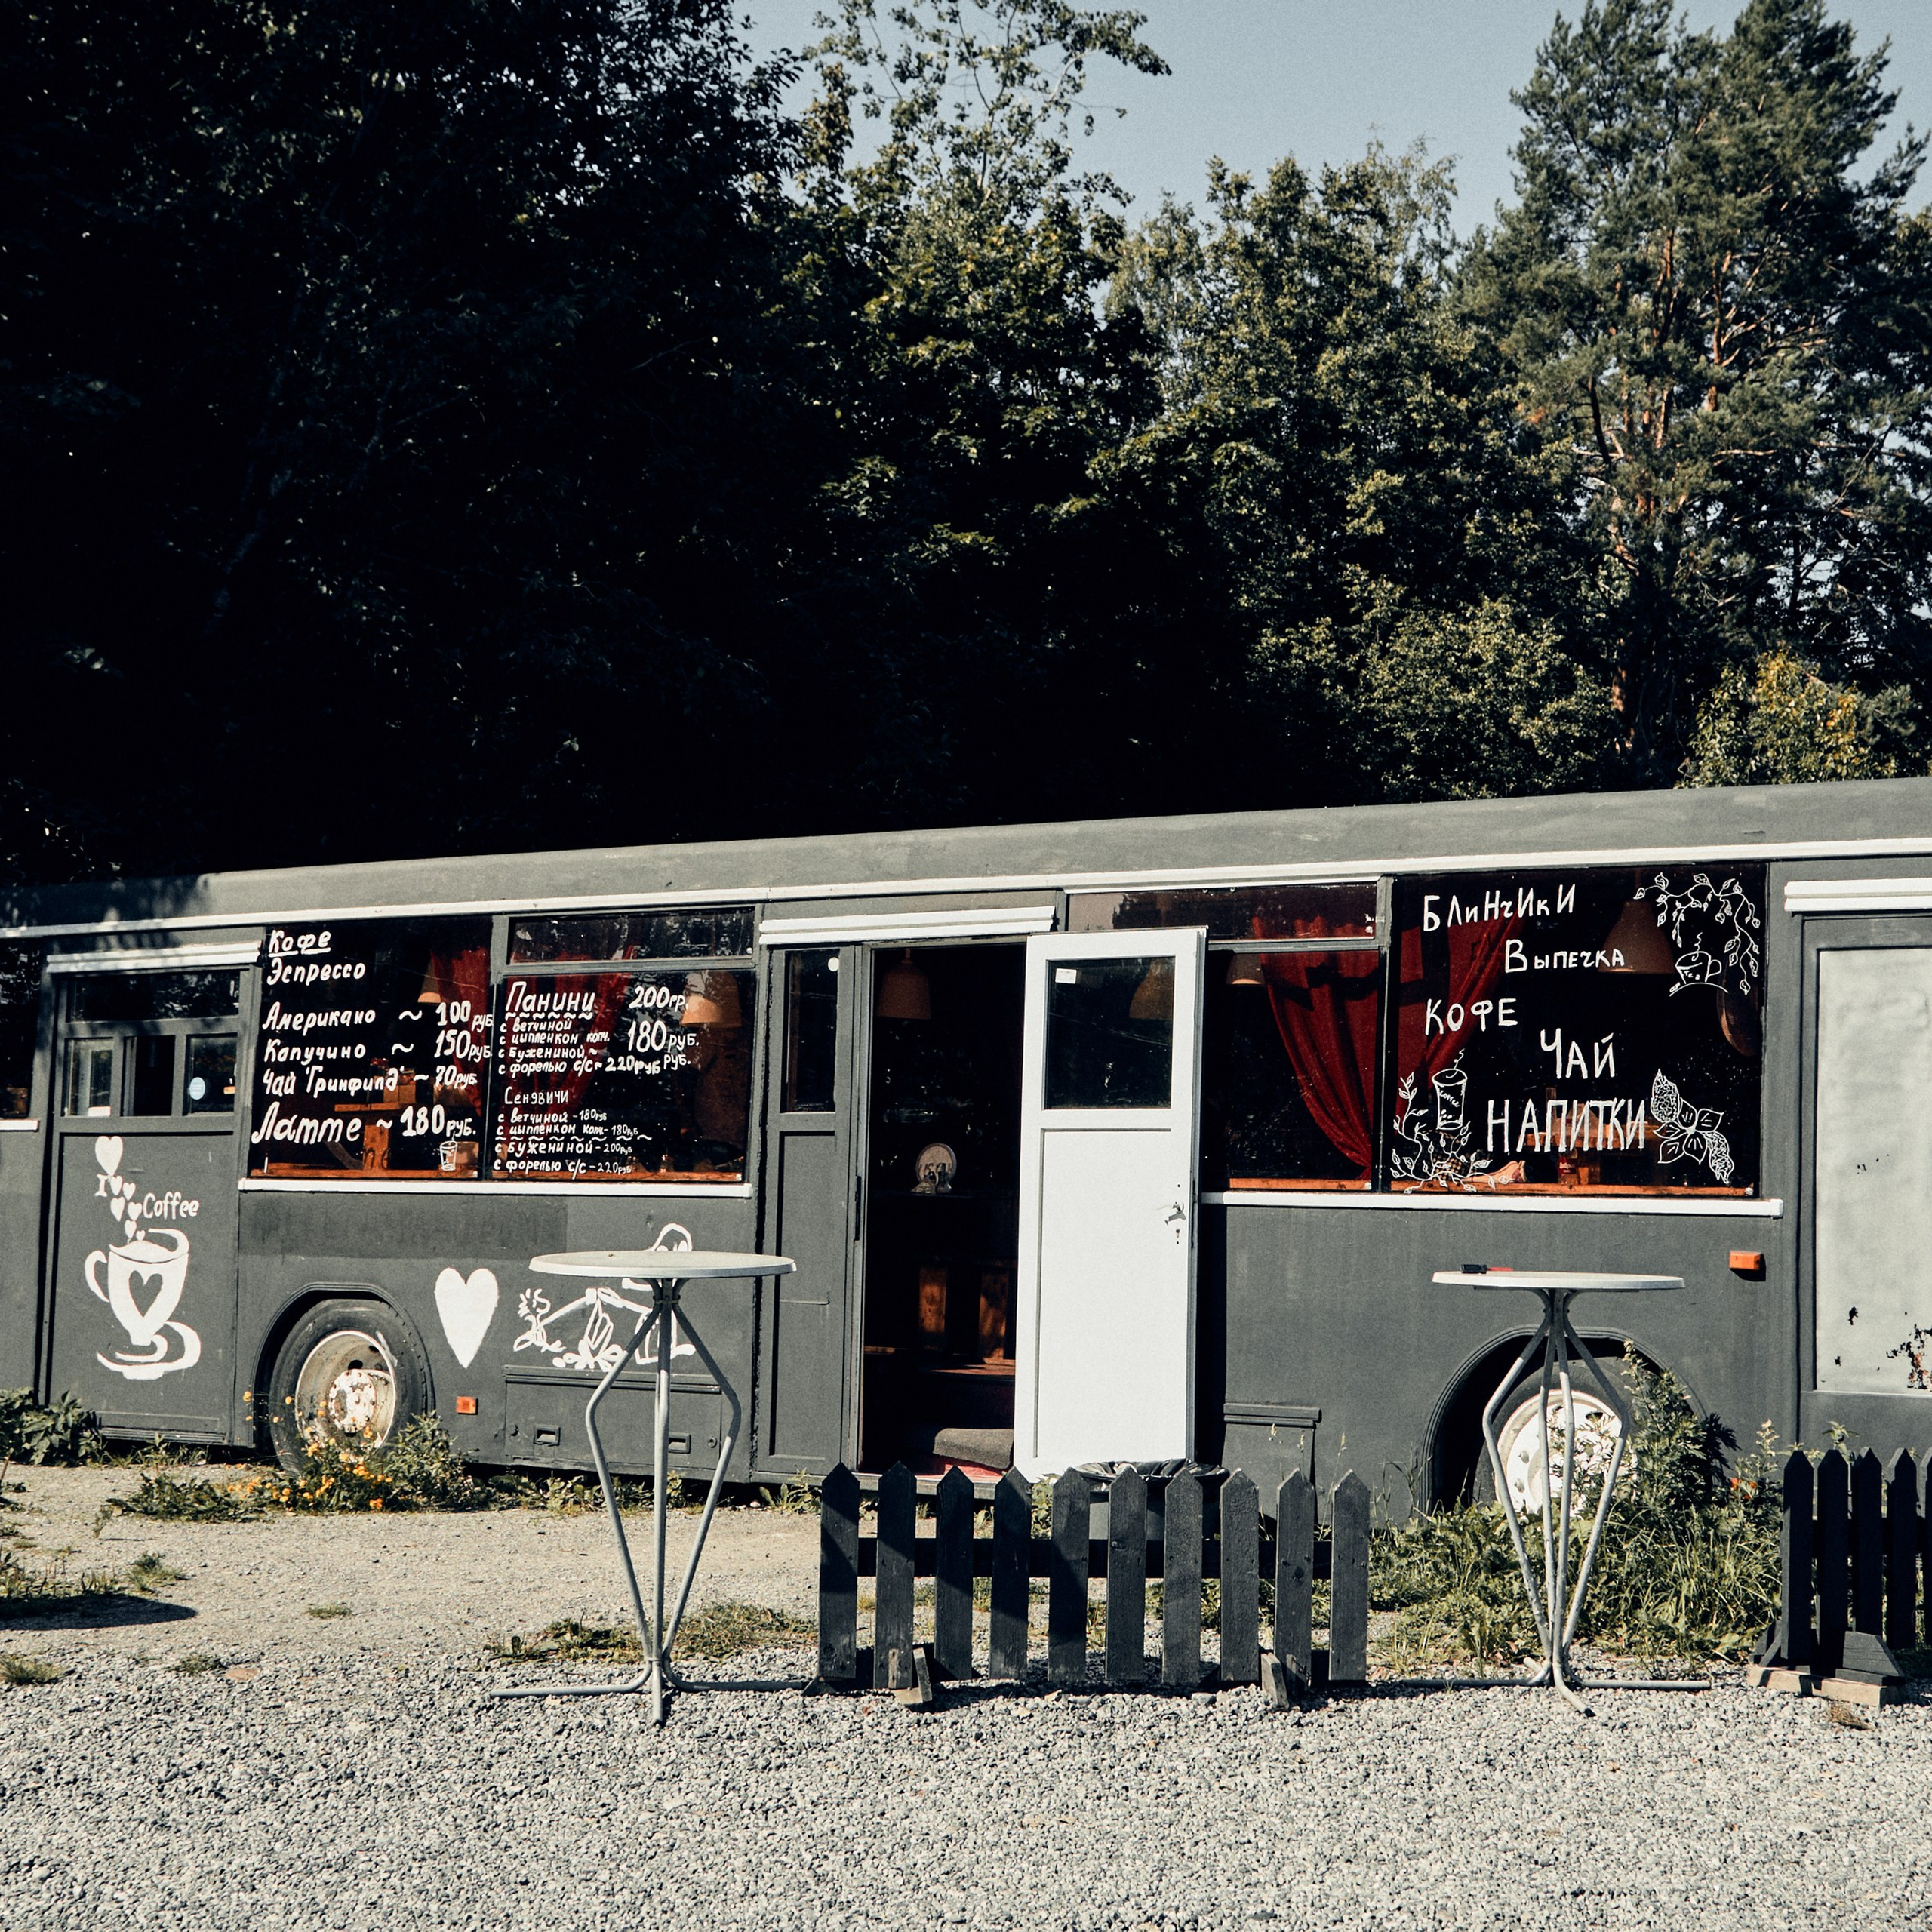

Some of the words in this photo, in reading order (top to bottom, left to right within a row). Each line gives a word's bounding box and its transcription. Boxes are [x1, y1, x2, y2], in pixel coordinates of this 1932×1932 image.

[268, 929, 332, 958] Кофе
[266, 957, 366, 986] Эспрессо
[505, 981, 595, 1012] Панини
[262, 1001, 376, 1036] Американо
[1425, 998, 1518, 1035] КОФЕ
[263, 1038, 366, 1066] Капучино
[1540, 1028, 1615, 1079] ЧАЙ
[263, 1068, 297, 1097] Чай
[509, 1061, 568, 1078] форелью
[251, 1101, 362, 1145] Латте
[1487, 1098, 1645, 1153] НАПИТКИ
[506, 1160, 562, 1175] форелью
[142, 1192, 200, 1220] Coffee
